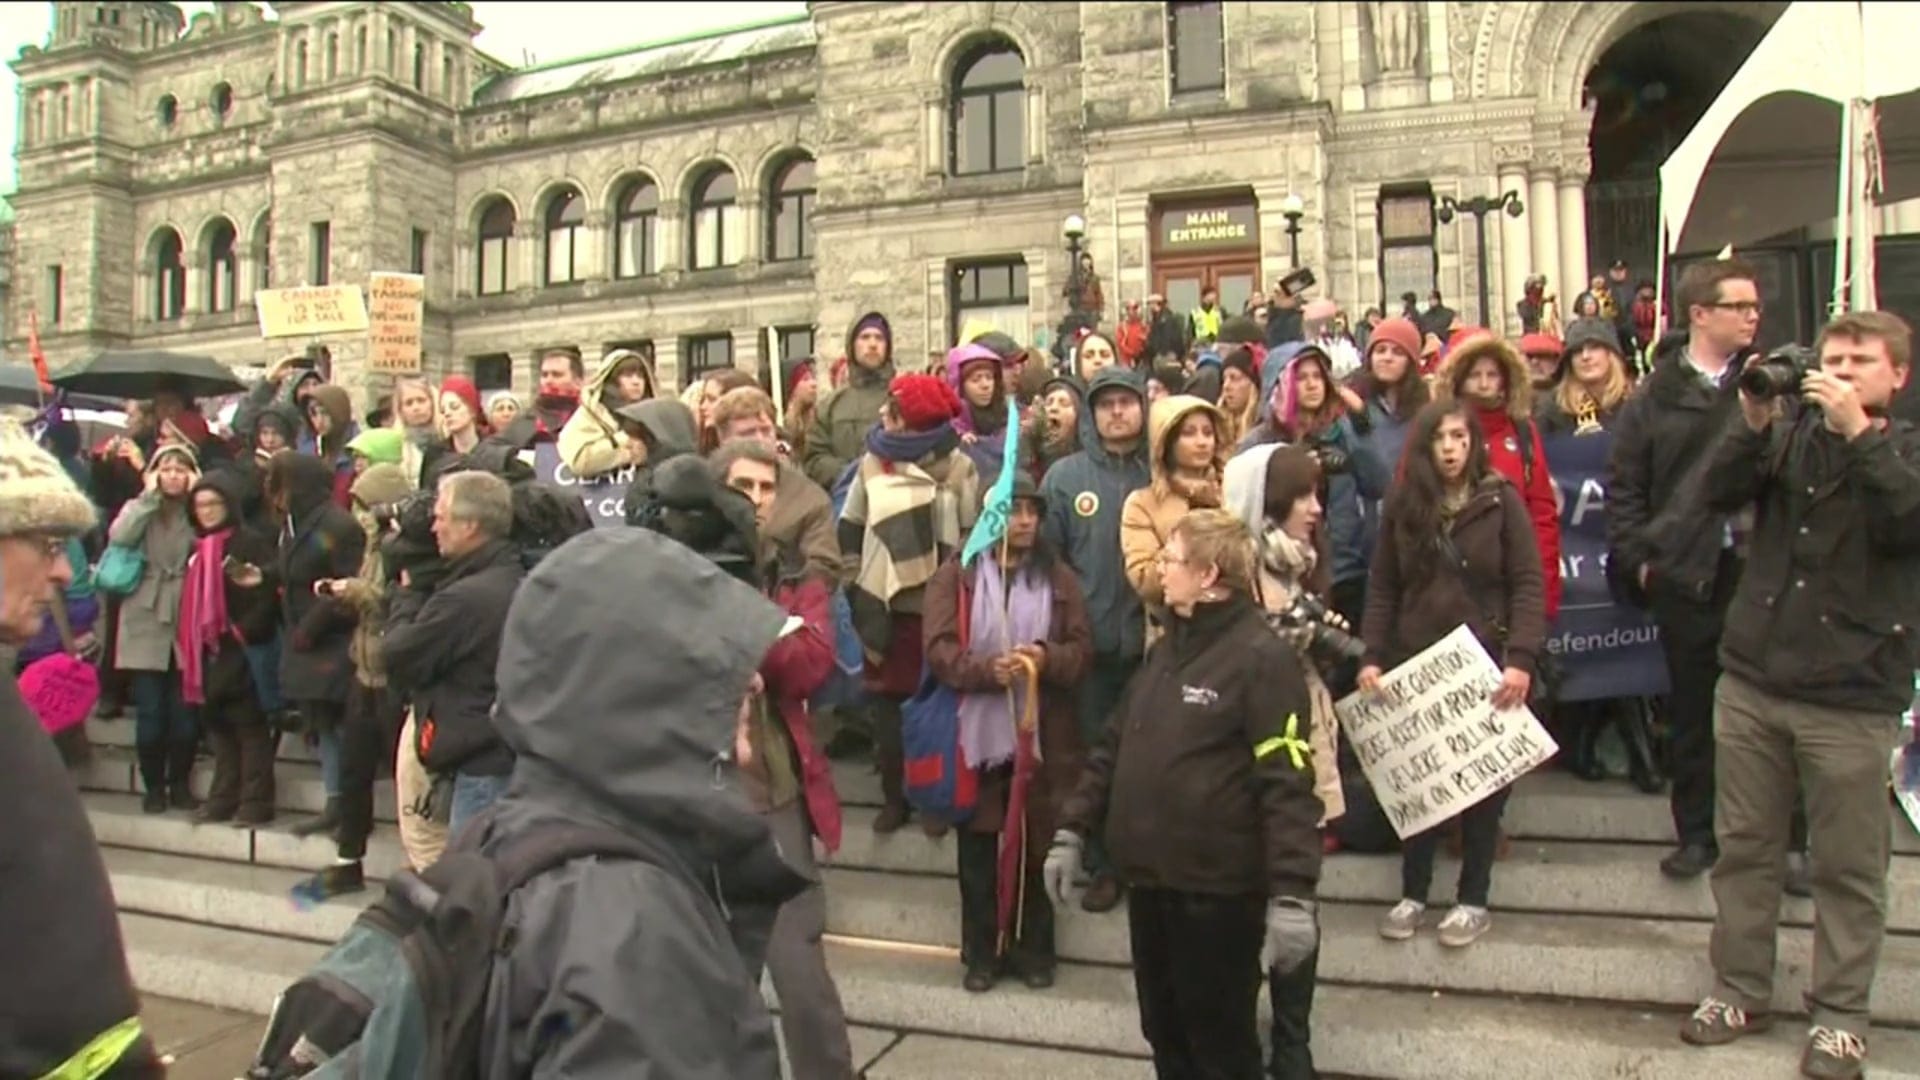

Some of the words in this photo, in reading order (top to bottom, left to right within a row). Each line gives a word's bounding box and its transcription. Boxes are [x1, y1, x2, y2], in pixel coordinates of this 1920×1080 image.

[1186, 209, 1228, 226] MAIN
[1169, 224, 1246, 242] ENTRANCE
[384, 278, 404, 288] NO
[281, 289, 344, 302] CANADA
[294, 303, 308, 314] IS
[314, 300, 339, 311] NOT
[384, 302, 404, 311] NO
[315, 311, 345, 322] SALE
[373, 359, 416, 369] HARPER
[1387, 708, 1428, 750] ACCEPT
[1423, 701, 1451, 735] OUR
[1403, 744, 1447, 784] WERE
[1444, 711, 1506, 758] ROLLING
[1429, 781, 1454, 806] ON
